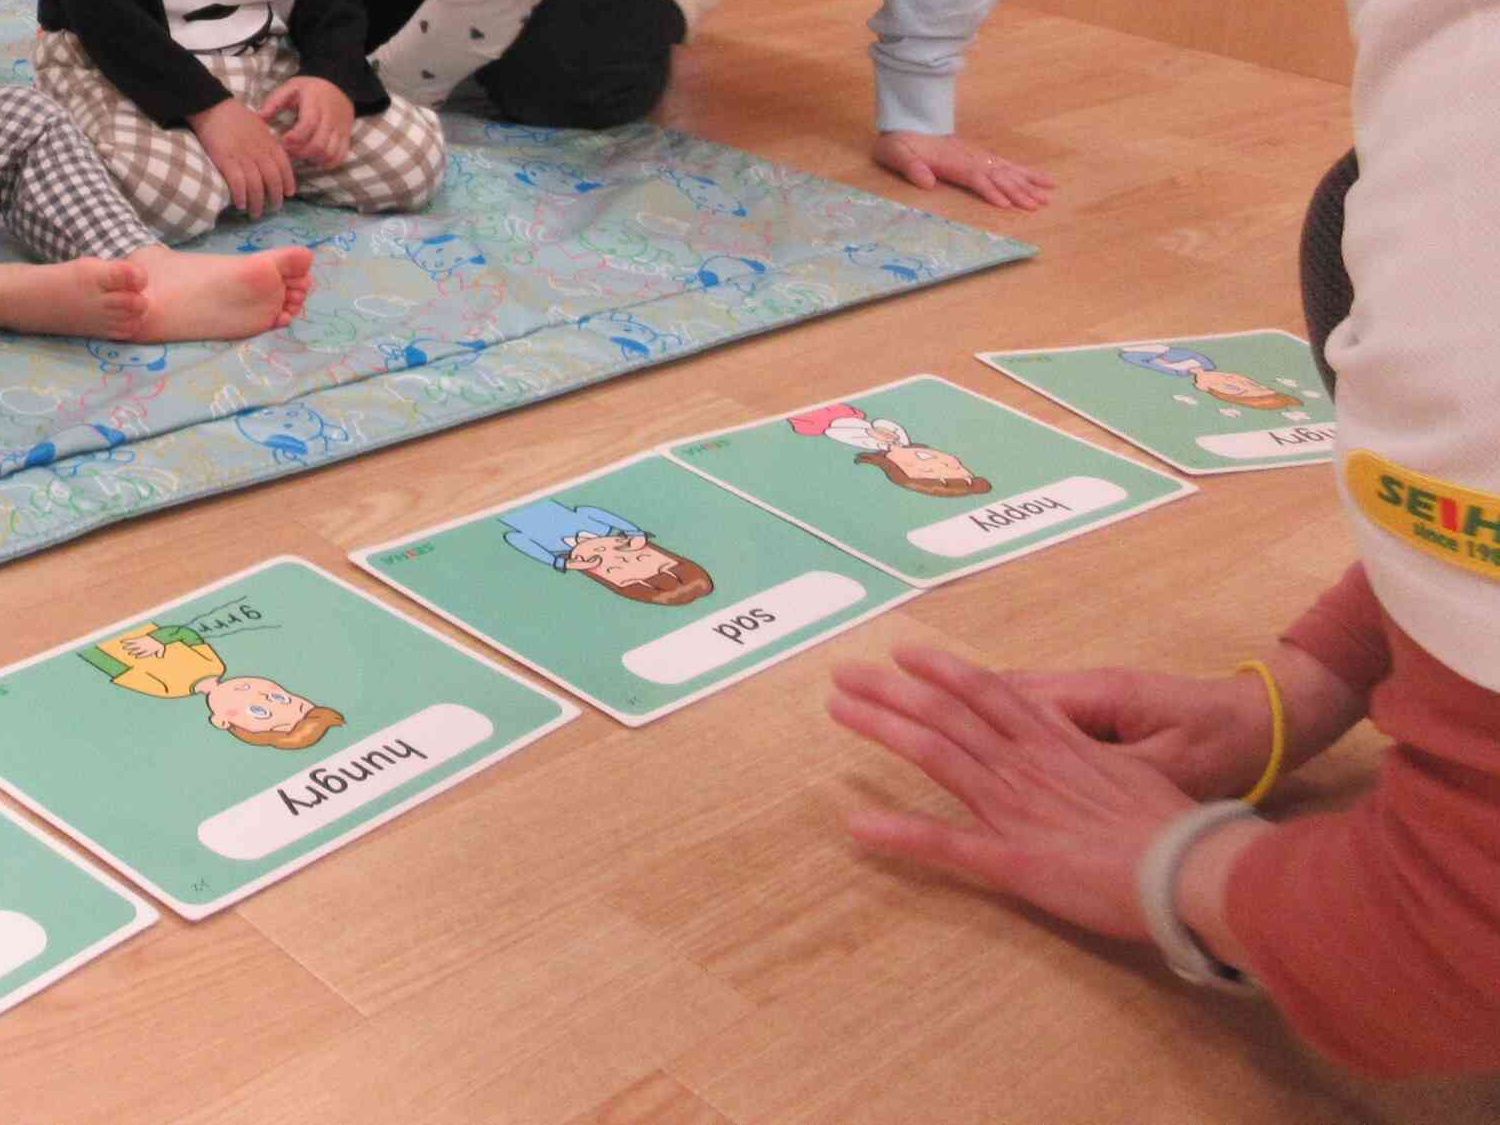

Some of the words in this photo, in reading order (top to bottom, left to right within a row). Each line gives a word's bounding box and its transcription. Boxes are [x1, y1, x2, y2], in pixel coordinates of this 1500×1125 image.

[1268, 426, 1338, 446] ngry
[971, 495, 1071, 532] happy
[381, 542, 437, 566] SEIHA
[198, 604, 262, 632] grrr
[713, 605, 775, 643] sad
[277, 738, 427, 815] hungry
